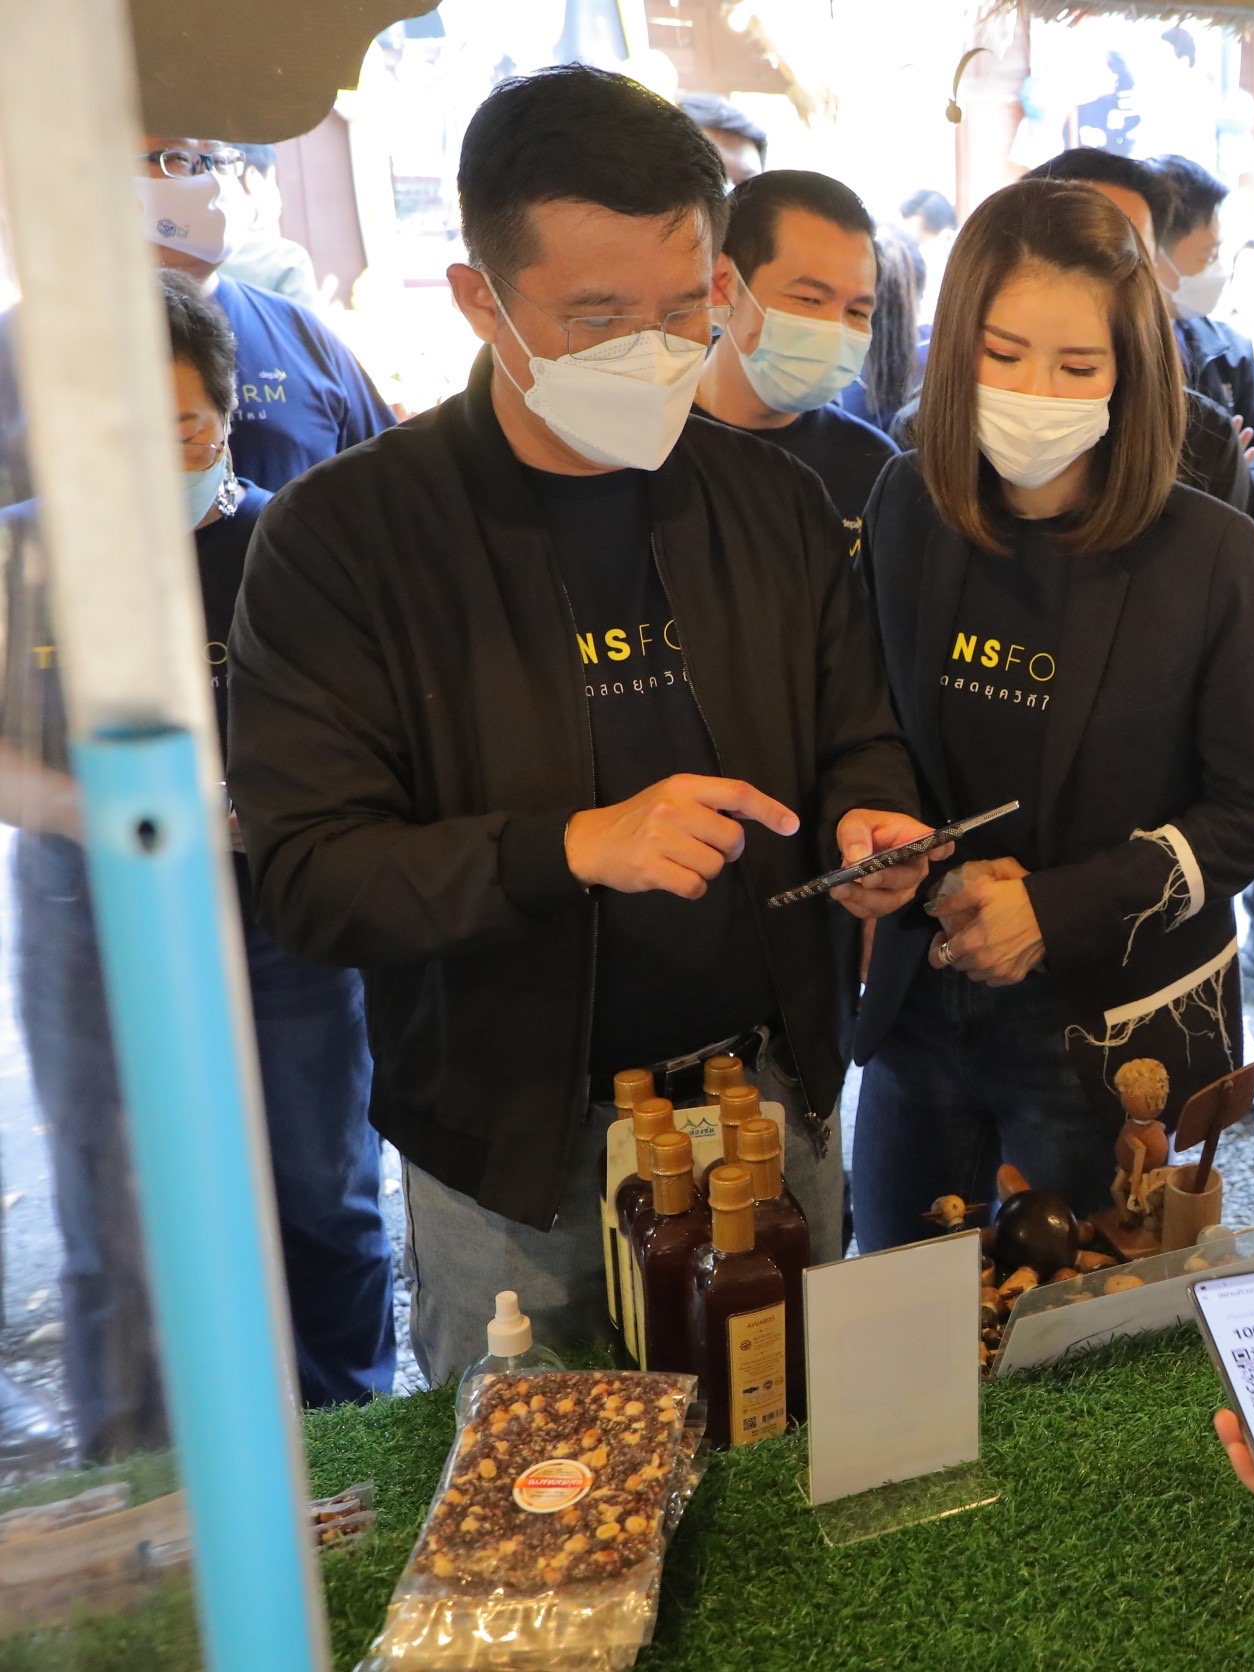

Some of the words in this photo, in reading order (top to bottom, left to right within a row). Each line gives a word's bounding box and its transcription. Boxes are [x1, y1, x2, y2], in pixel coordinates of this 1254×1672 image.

[242, 384, 286, 403] RM
[952, 632, 1055, 682] NSFO
[747, 1315, 776, 1329] AWARDS
